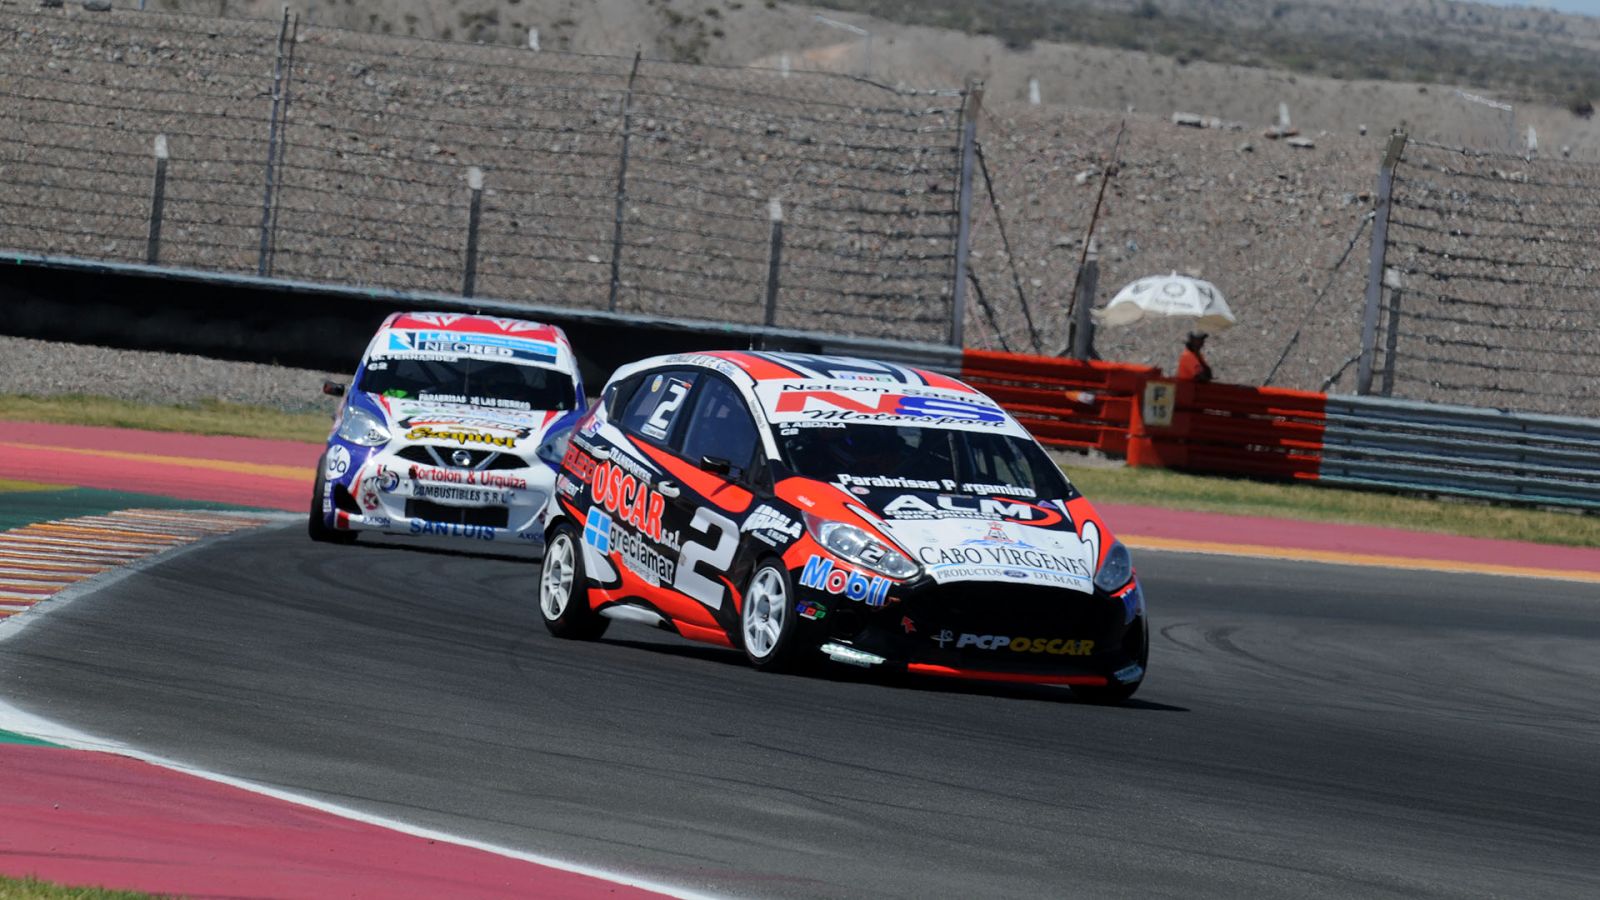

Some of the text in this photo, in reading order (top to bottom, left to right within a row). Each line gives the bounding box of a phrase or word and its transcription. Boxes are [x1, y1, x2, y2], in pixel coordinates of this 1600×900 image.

[424, 342, 514, 358] NEORED
[782, 383, 890, 394] Nelson
[648, 384, 687, 430] 2
[803, 409, 1009, 431] Motorsport
[466, 471, 476, 485] &
[480, 470, 527, 490] Urquiza
[837, 473, 1037, 498] Parabrisas Prgamino
[413, 484, 481, 502] COMBUSTIBLES
[591, 460, 665, 544] OSCAR
[882, 494, 1033, 520] ALM
[410, 518, 496, 541] SAN LUIS
[609, 523, 675, 584] greciamar
[673, 506, 740, 611] 2
[859, 543, 886, 563] 2
[919, 546, 1092, 579] CABO VÍRGENES
[799, 554, 892, 607] Mobil
[937, 567, 1001, 580] PRODUCTOS
[1033, 571, 1051, 582] DE
[1053, 574, 1082, 588] MAR
